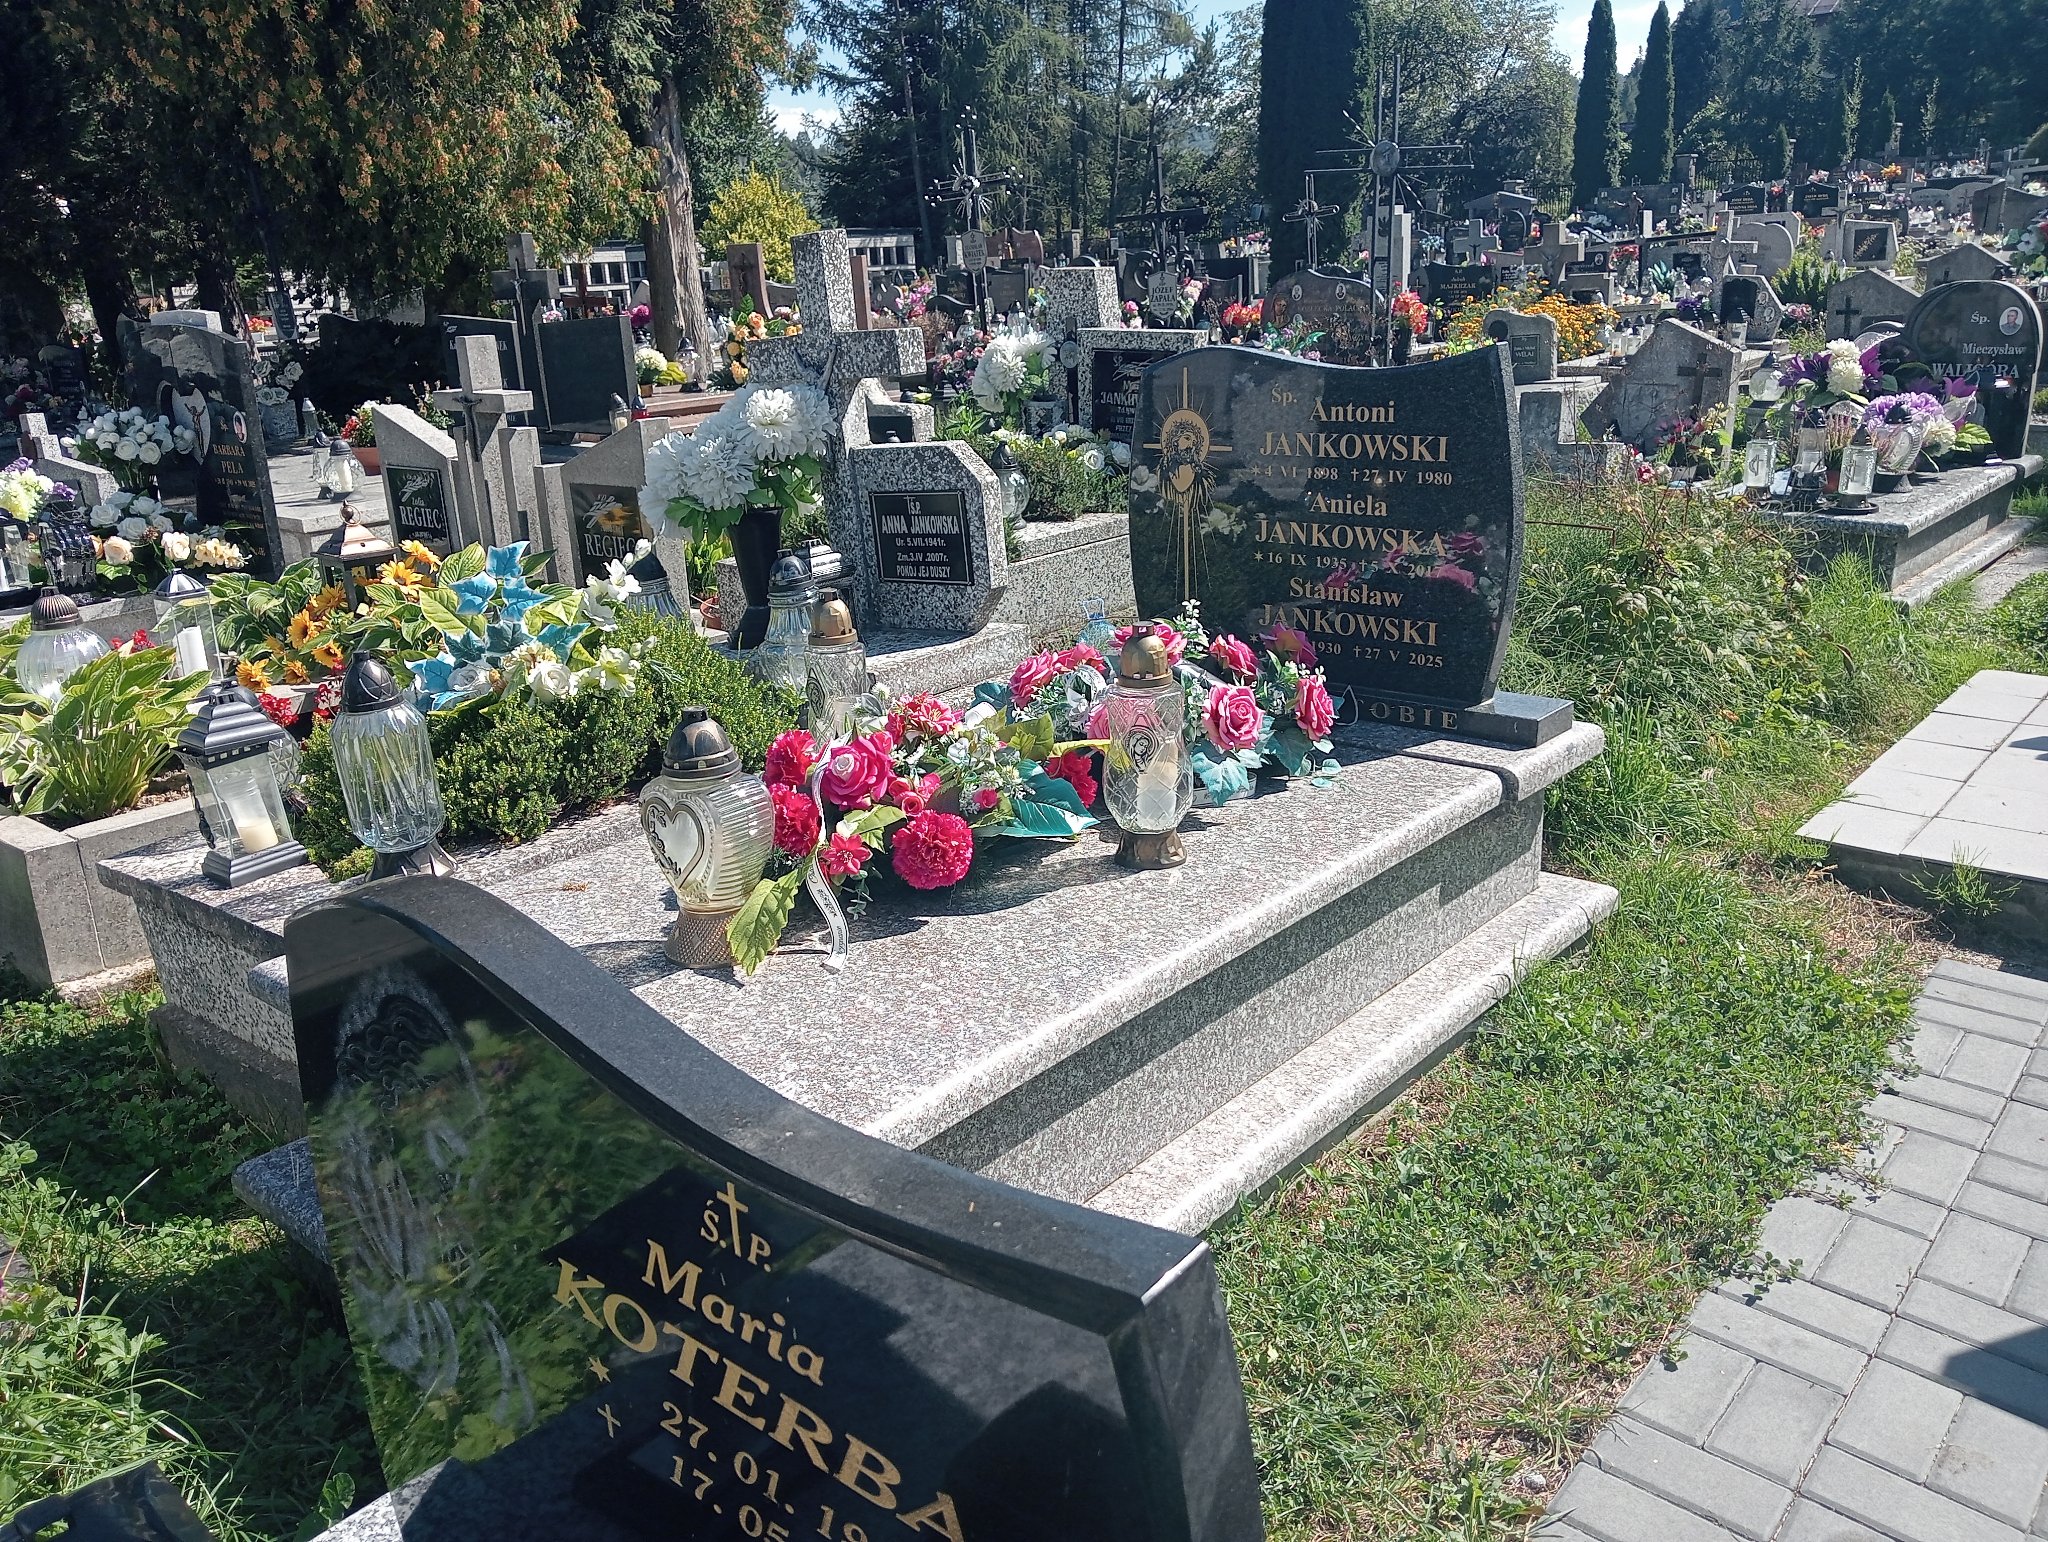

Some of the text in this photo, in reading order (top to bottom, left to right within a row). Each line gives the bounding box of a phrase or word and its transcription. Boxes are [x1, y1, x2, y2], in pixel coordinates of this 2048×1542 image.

[1970, 310, 1991, 325] Śp.
[1271, 383, 1298, 407] Śp.
[1309, 399, 1395, 424] Antoni
[1259, 430, 1449, 463] JANKOWSKI
[220, 460, 245, 475] PELA
[1307, 466, 1339, 481] 1898
[1362, 468, 1379, 482] 27
[1388, 469, 1408, 484] IV
[1417, 471, 1453, 487] 1980
[1309, 491, 1388, 517] Aniela
[399, 505, 442, 529] REGIEC
[881, 514, 960, 535] ANNA JANKOWSKA
[1255, 519, 1448, 557] JANKOWSKA
[896, 562, 951, 578] POKÓJ JEJ DUSZY
[1267, 552, 1283, 564] 16
[1290, 553, 1307, 566] IX
[1316, 555, 1347, 569] 1935
[1289, 577, 1404, 609] Stanisław
[1258, 603, 1439, 646] JANKOWSKI
[1312, 641, 1443, 668] 1930 27 V 2025
[1366, 700, 1459, 731] OBIE
[641, 1238, 825, 1387] Maria
[552, 1257, 966, 1542] KOTERBA
